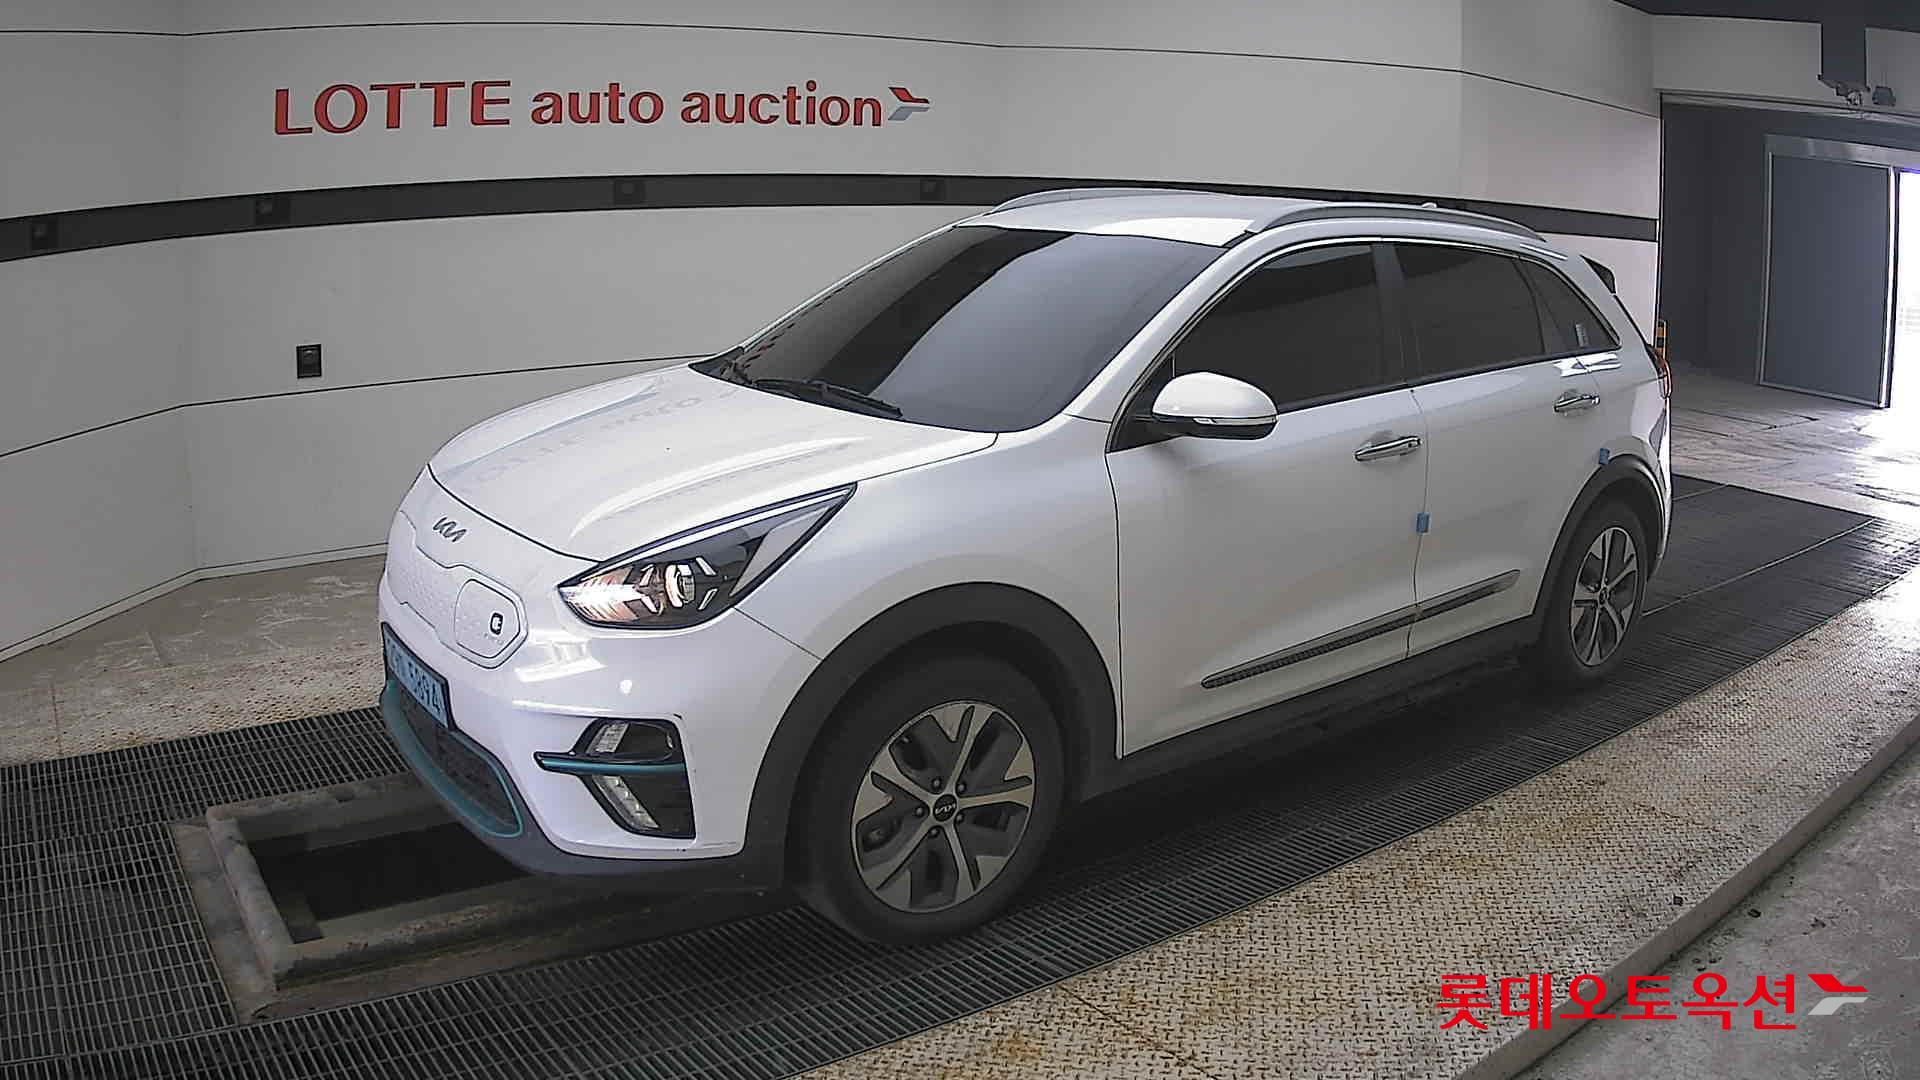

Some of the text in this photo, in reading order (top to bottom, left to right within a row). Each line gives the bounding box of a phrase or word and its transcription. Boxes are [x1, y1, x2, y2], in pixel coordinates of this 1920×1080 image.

[274, 80, 882, 135] LOTTE auto auction
